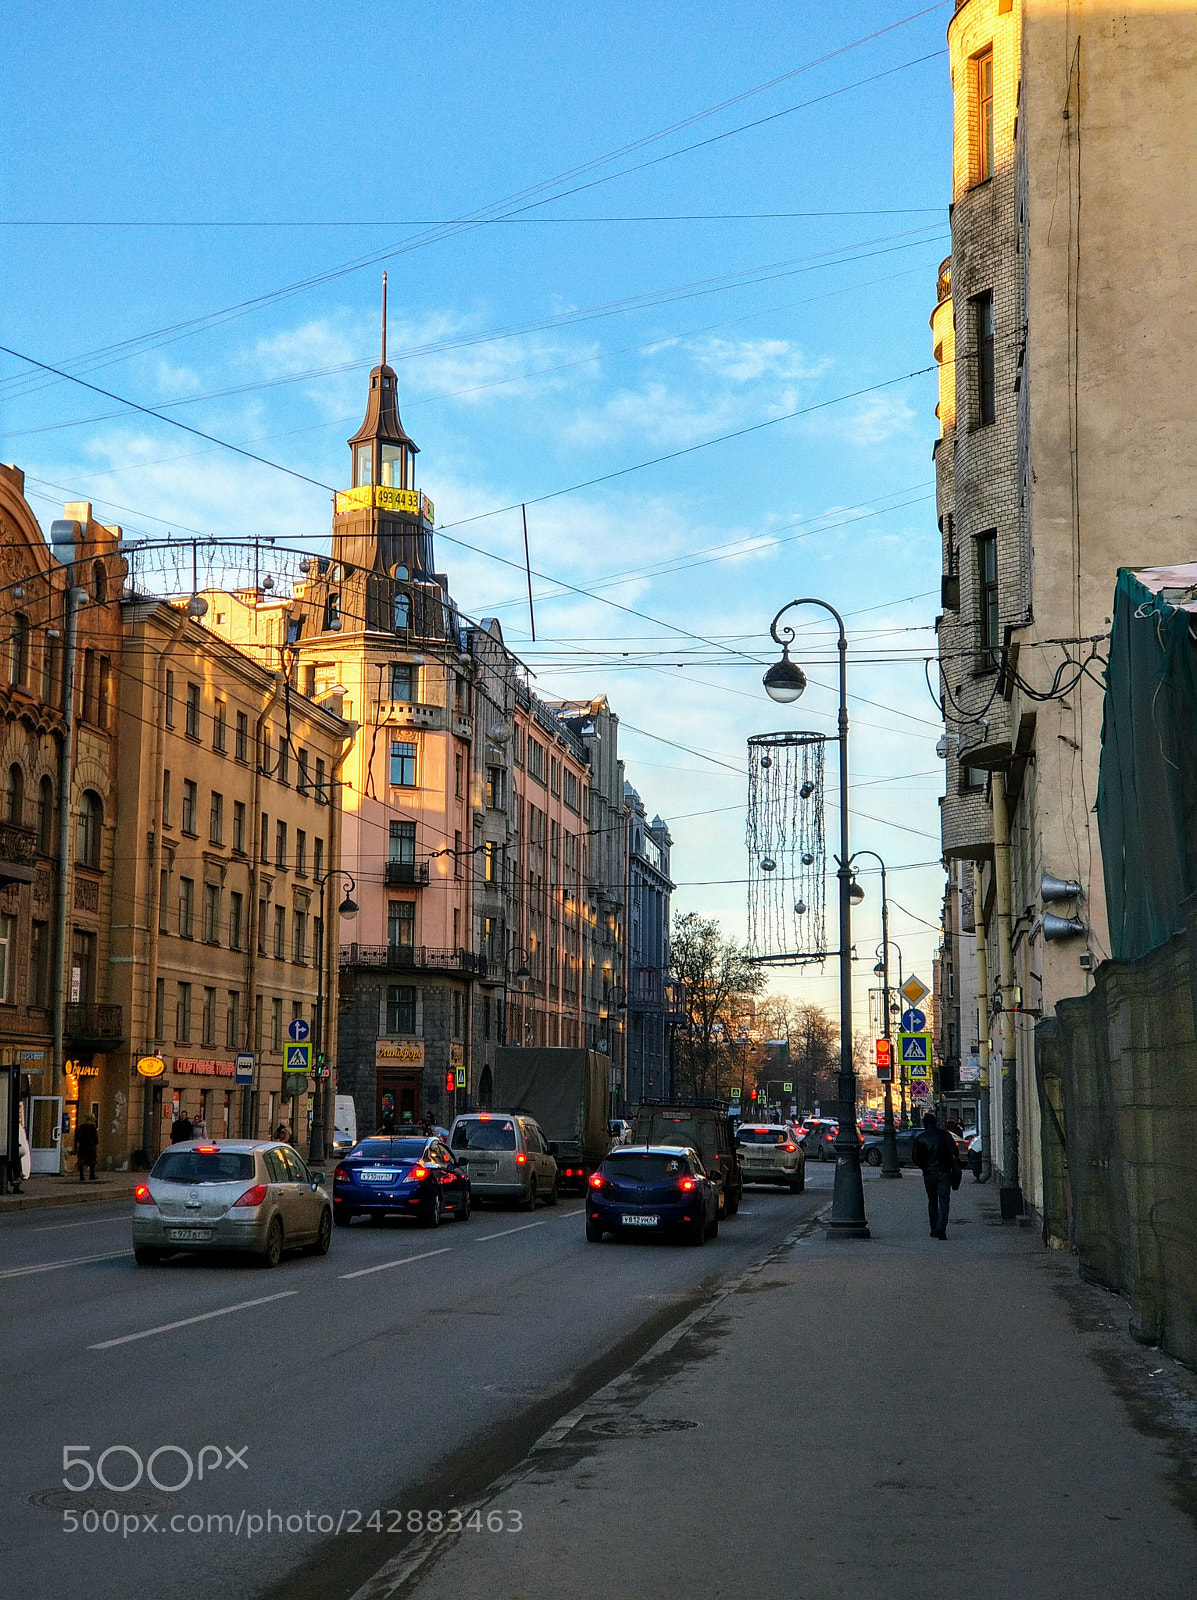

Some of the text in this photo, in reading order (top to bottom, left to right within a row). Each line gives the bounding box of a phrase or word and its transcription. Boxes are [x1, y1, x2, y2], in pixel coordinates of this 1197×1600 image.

[378, 490, 418, 507] 493 44 33
